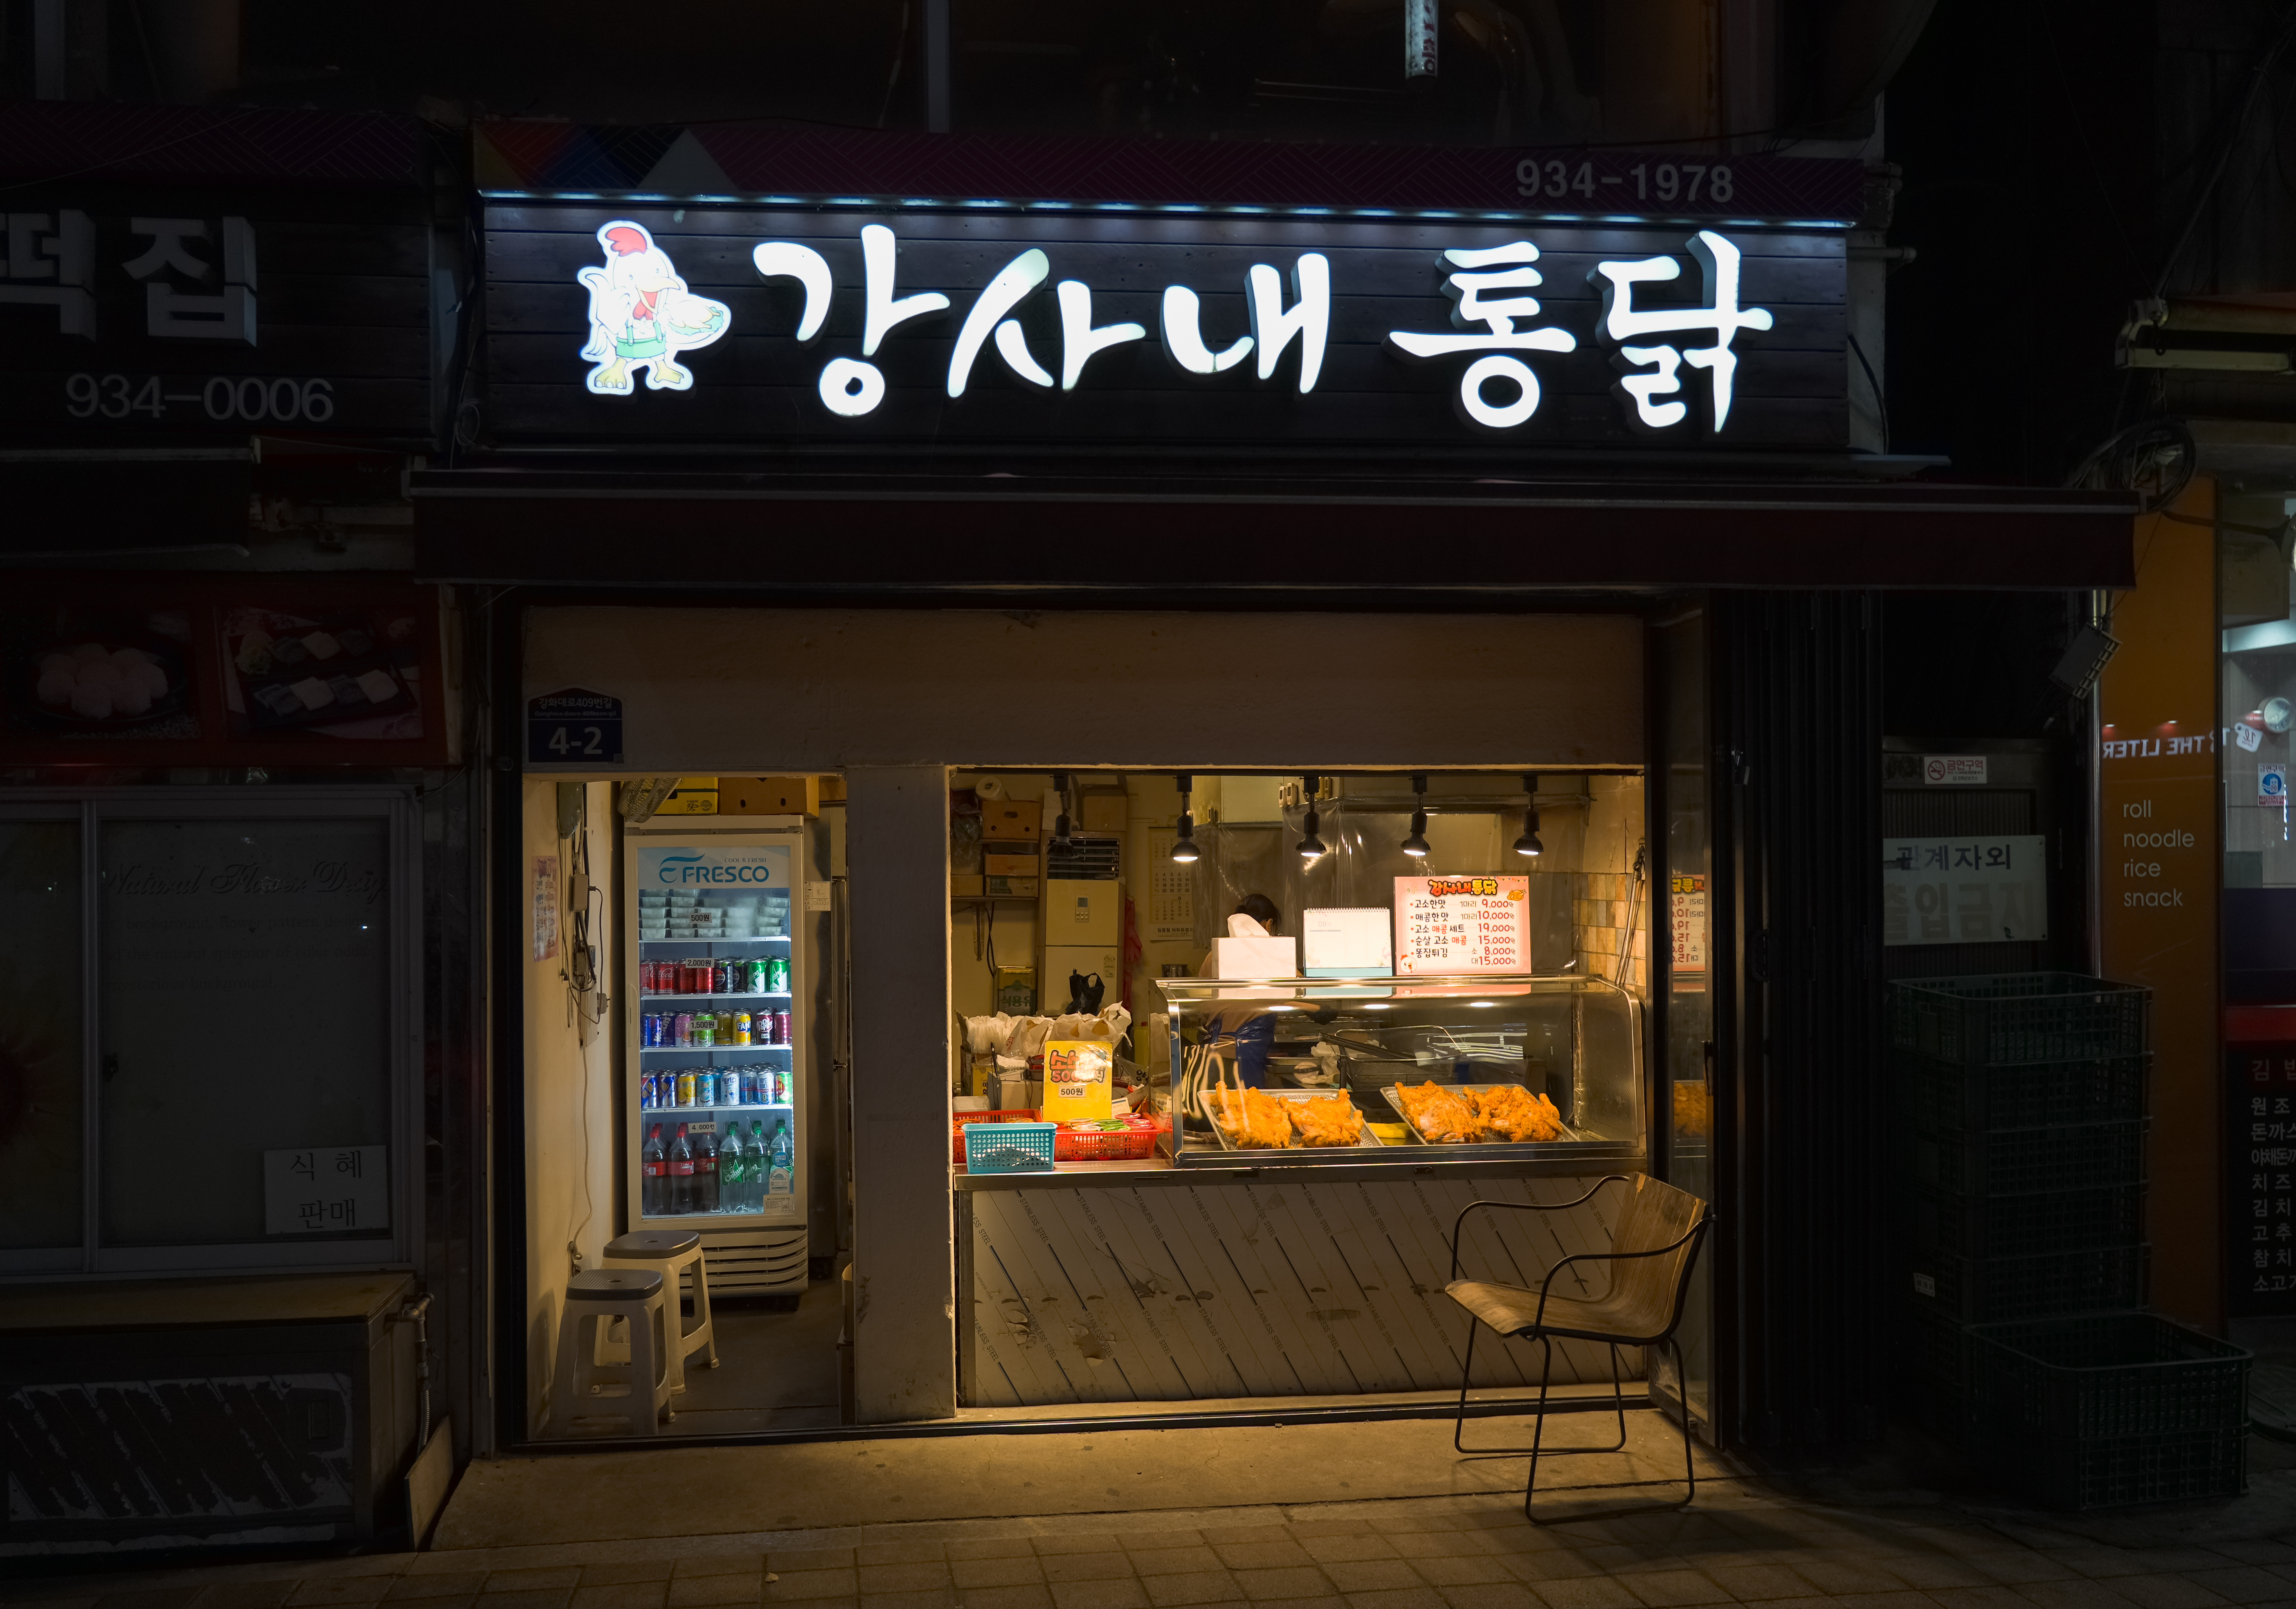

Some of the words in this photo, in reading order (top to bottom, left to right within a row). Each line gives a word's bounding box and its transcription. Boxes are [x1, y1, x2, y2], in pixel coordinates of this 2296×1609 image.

[1515, 160, 1734, 204] 934-1978
[753, 224, 1331, 417] 강사내
[1386, 230, 1774, 435] 통닭
[65, 373, 335, 422] 934-0006
[539, 698, 612, 709] 강화대로409번길
[549, 727, 603, 755] 4-2
[1947, 760, 1983, 770] 금연구역
[2124, 799, 2151, 818] roll
[1896, 844, 2010, 871] 관계자외
[2124, 829, 2194, 848] noodle
[313, 860, 383, 905] Desig
[682, 866, 769, 883] FRESCO
[1428, 879, 1498, 896] 강사내통닭
[2124, 859, 2161, 878] rice
[1415, 900, 1446, 909] 고소한맛
[1482, 899, 1513, 909] 9,000원
[1477, 911, 1514, 920] 10,000원
[2124, 888, 2183, 907] snack
[1416, 936, 1431, 945] 순살
[1434, 936, 1448, 944] 고소
[1452, 936, 1467, 945] 매콤
[1478, 935, 1515, 945] 15,000원
[1432, 925, 1447, 934] 매콤
[1450, 924, 1464, 932] 세트
[1478, 923, 1515, 933] 19,000원
[1416, 948, 1448, 958] 똥집튀김
[1484, 946, 1516, 956] 8,000원
[1479, 956, 1516, 965] 15,000원
[1001, 996, 1031, 1007] 식용유
[299, 1199, 357, 1229] 판매
[1020, 1198, 1039, 1226] STAINLESS
[1037, 1227, 1049, 1243] STEEL
[1077, 1197, 1097, 1225] STAINLESS
[1094, 1226, 1106, 1242] STEEL
[1135, 1195, 1154, 1224] STAINLESS
[1151, 1224, 1163, 1240] STEEL
[1192, 1194, 1210, 1222] STAINLESS
[1208, 1222, 1219, 1238] STEEL
[1248, 1192, 1267, 1220] STAINLESS
[1264, 1221, 1275, 1237] STEEL
[1304, 1191, 1322, 1219] STAINLESS
[1320, 1220, 1331, 1235] STEEL
[1359, 1189, 1378, 1217] STAINLESS
[1376, 1218, 1387, 1234] STEEL
[1414, 1188, 1433, 1215] STAINLESS
[1430, 1217, 1442, 1233] STEEL
[1028, 1314, 1047, 1342] STAINLESS
[1045, 1343, 1057, 1359] STEEL
[1142, 1311, 1162, 1339] STAINLESS
[1159, 1339, 1171, 1356] STEEL
[1199, 1308, 1218, 1336] STAINLESS
[1215, 1337, 1227, 1353] STEEL
[1255, 1306, 1274, 1334] STAINLESS
[1272, 1335, 1284, 1351] STEEL
[1311, 1304, 1330, 1332] STAINLESS
[1328, 1333, 1339, 1350] STEEL
[1367, 1303, 1386, 1331] STAINLESS
[1383, 1332, 1395, 1348] STEEL
[1422, 1301, 1441, 1329] STAINLESS
[1438, 1330, 1450, 1345] STEEL
